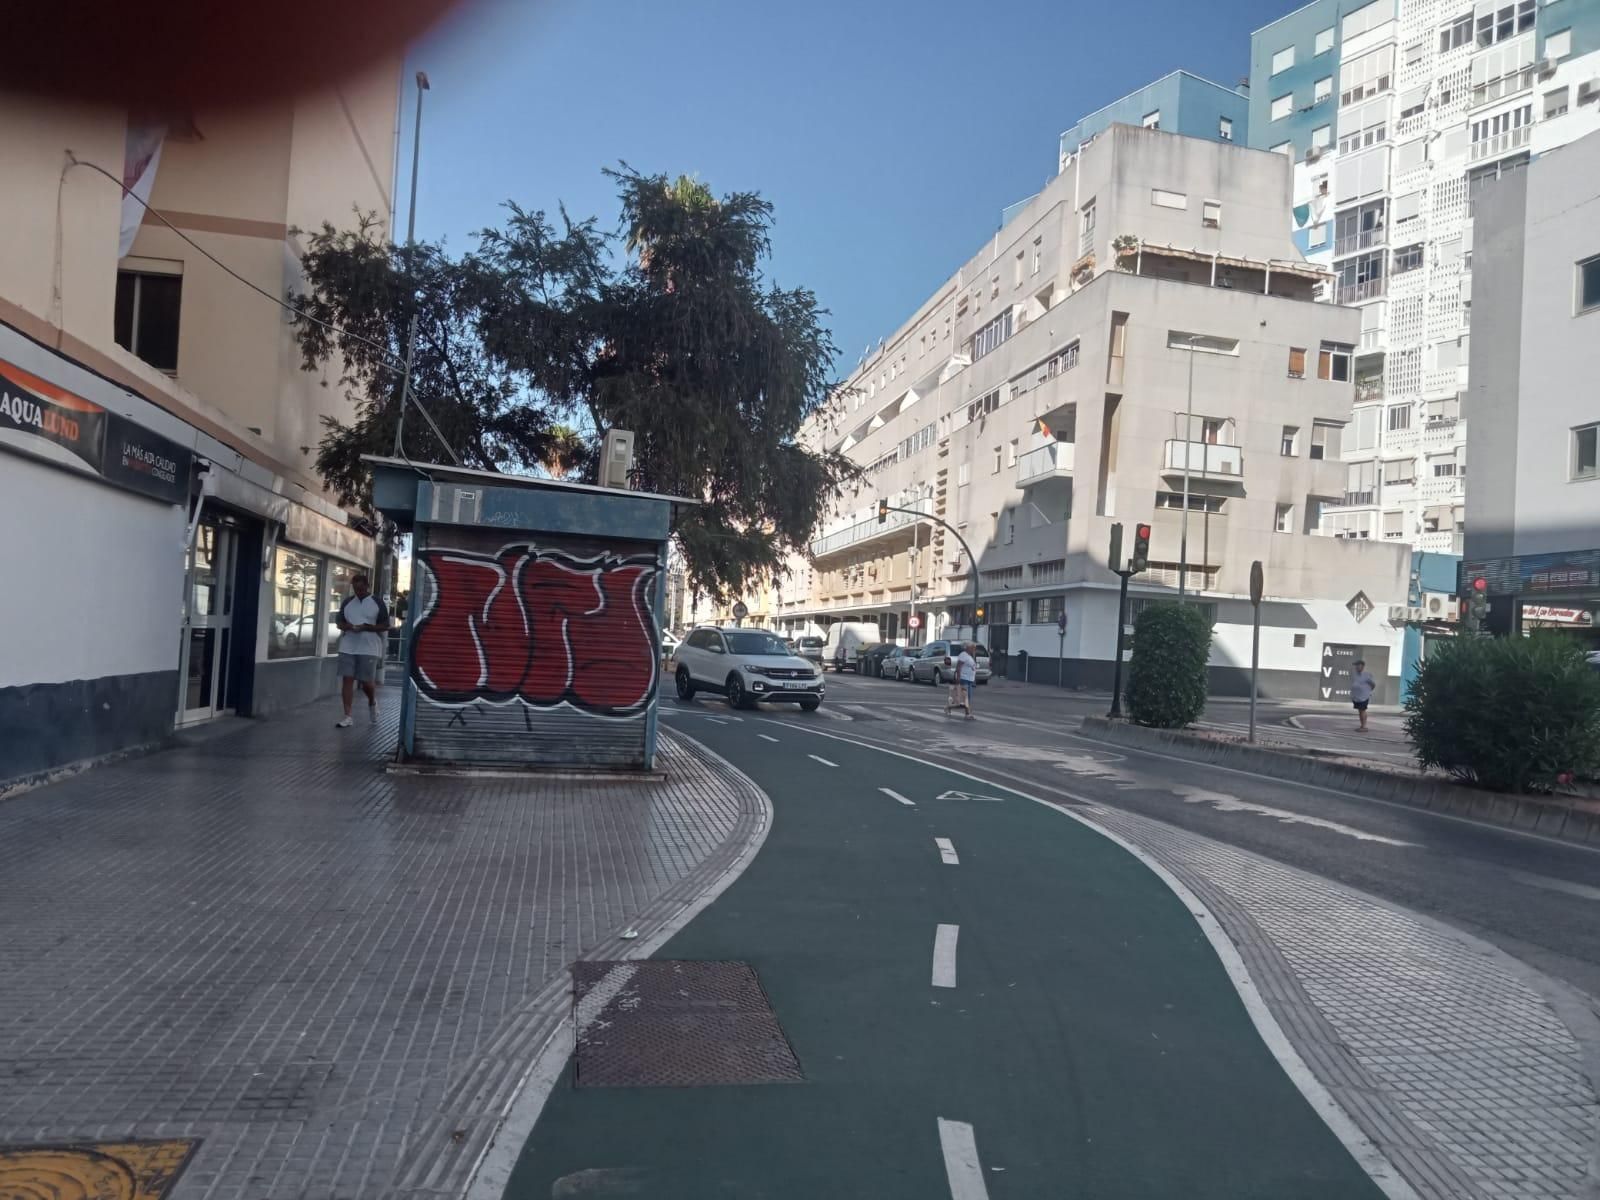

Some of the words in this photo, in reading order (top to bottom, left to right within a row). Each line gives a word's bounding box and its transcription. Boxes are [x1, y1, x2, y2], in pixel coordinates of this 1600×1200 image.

[0, 391, 80, 441] AQUALUND
[1323, 646, 1333, 657] A
[1323, 666, 1333, 678] V
[1321, 687, 1332, 699] V
